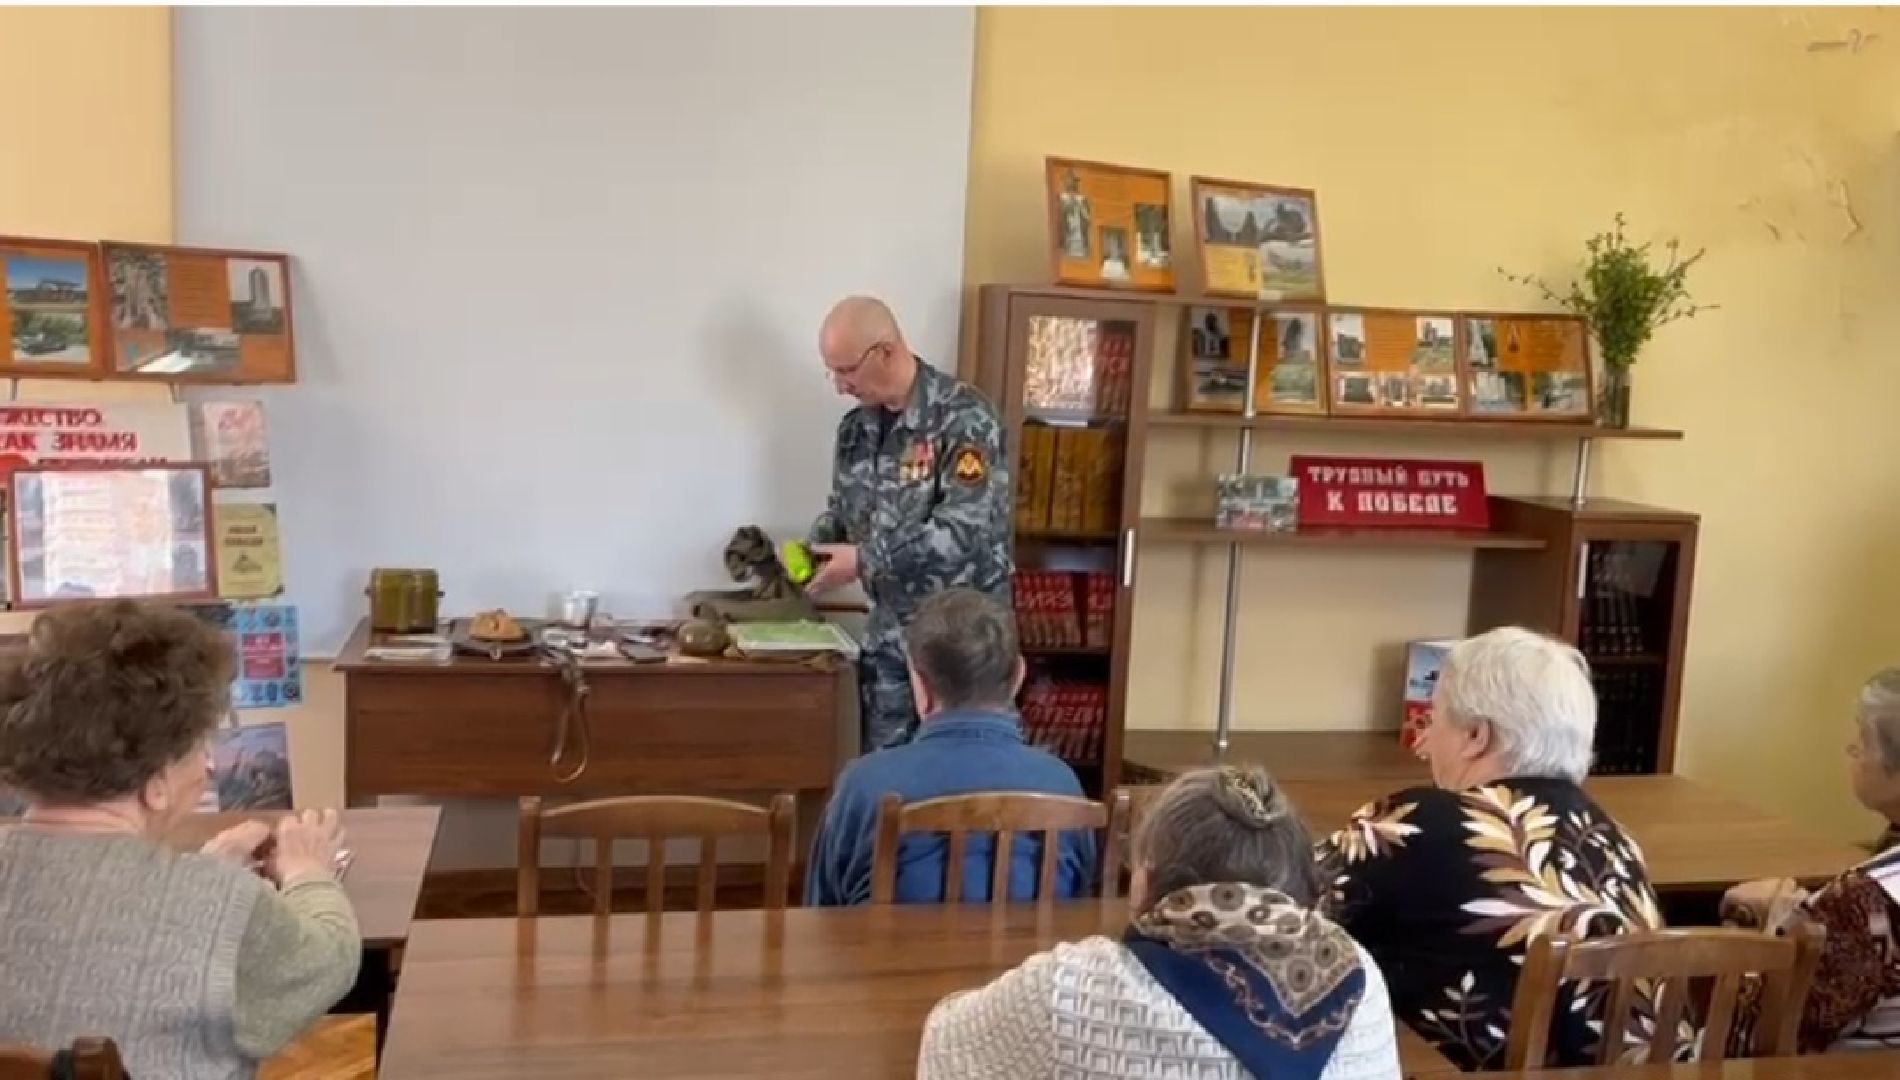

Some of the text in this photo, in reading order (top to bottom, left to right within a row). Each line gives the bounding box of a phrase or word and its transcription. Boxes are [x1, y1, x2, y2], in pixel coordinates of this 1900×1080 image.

[51, 431, 138, 452] ЗНАМЯ
[1307, 464, 1469, 488] ТРУДНЫЙ ПУТЬ
[1327, 489, 1457, 514] К ПОБЕДЕ
